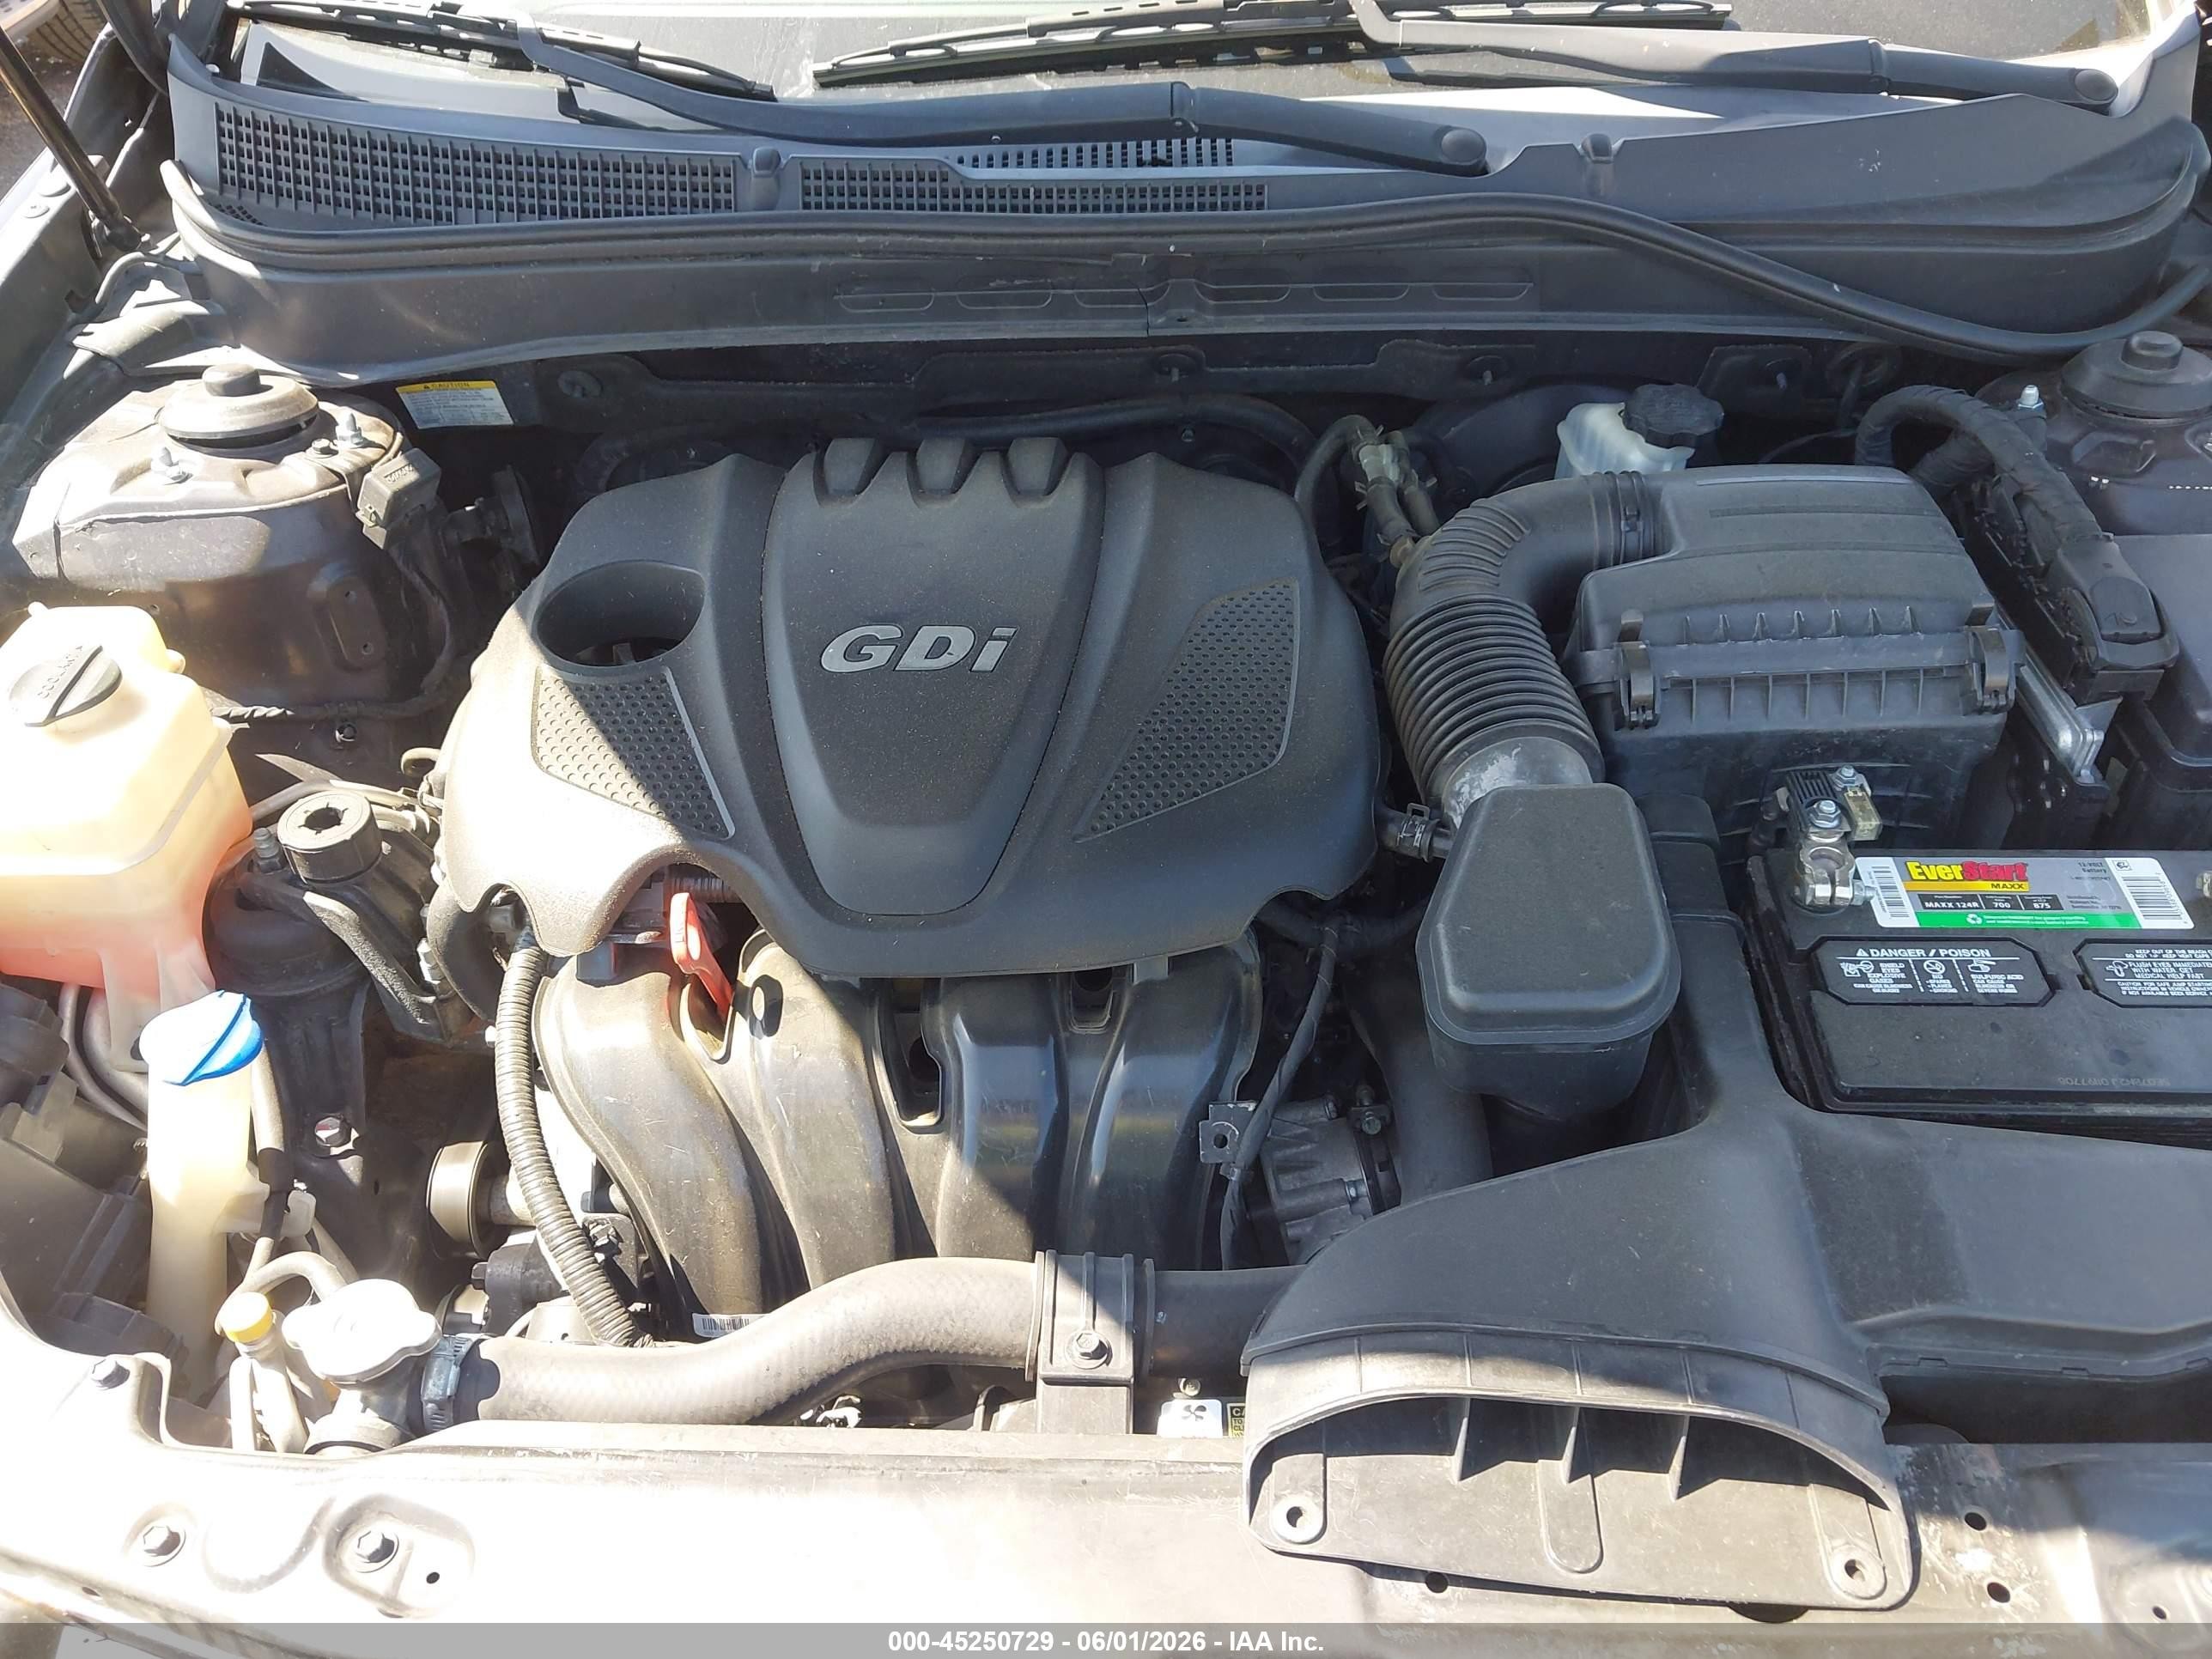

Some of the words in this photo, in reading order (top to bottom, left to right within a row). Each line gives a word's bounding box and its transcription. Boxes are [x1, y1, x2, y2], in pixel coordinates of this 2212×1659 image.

[820, 624, 1018, 672] GDi
[1905, 860, 2028, 881] EverStart
[1869, 948, 1927, 957] DANGER
[1938, 948, 1991, 957] POISON
